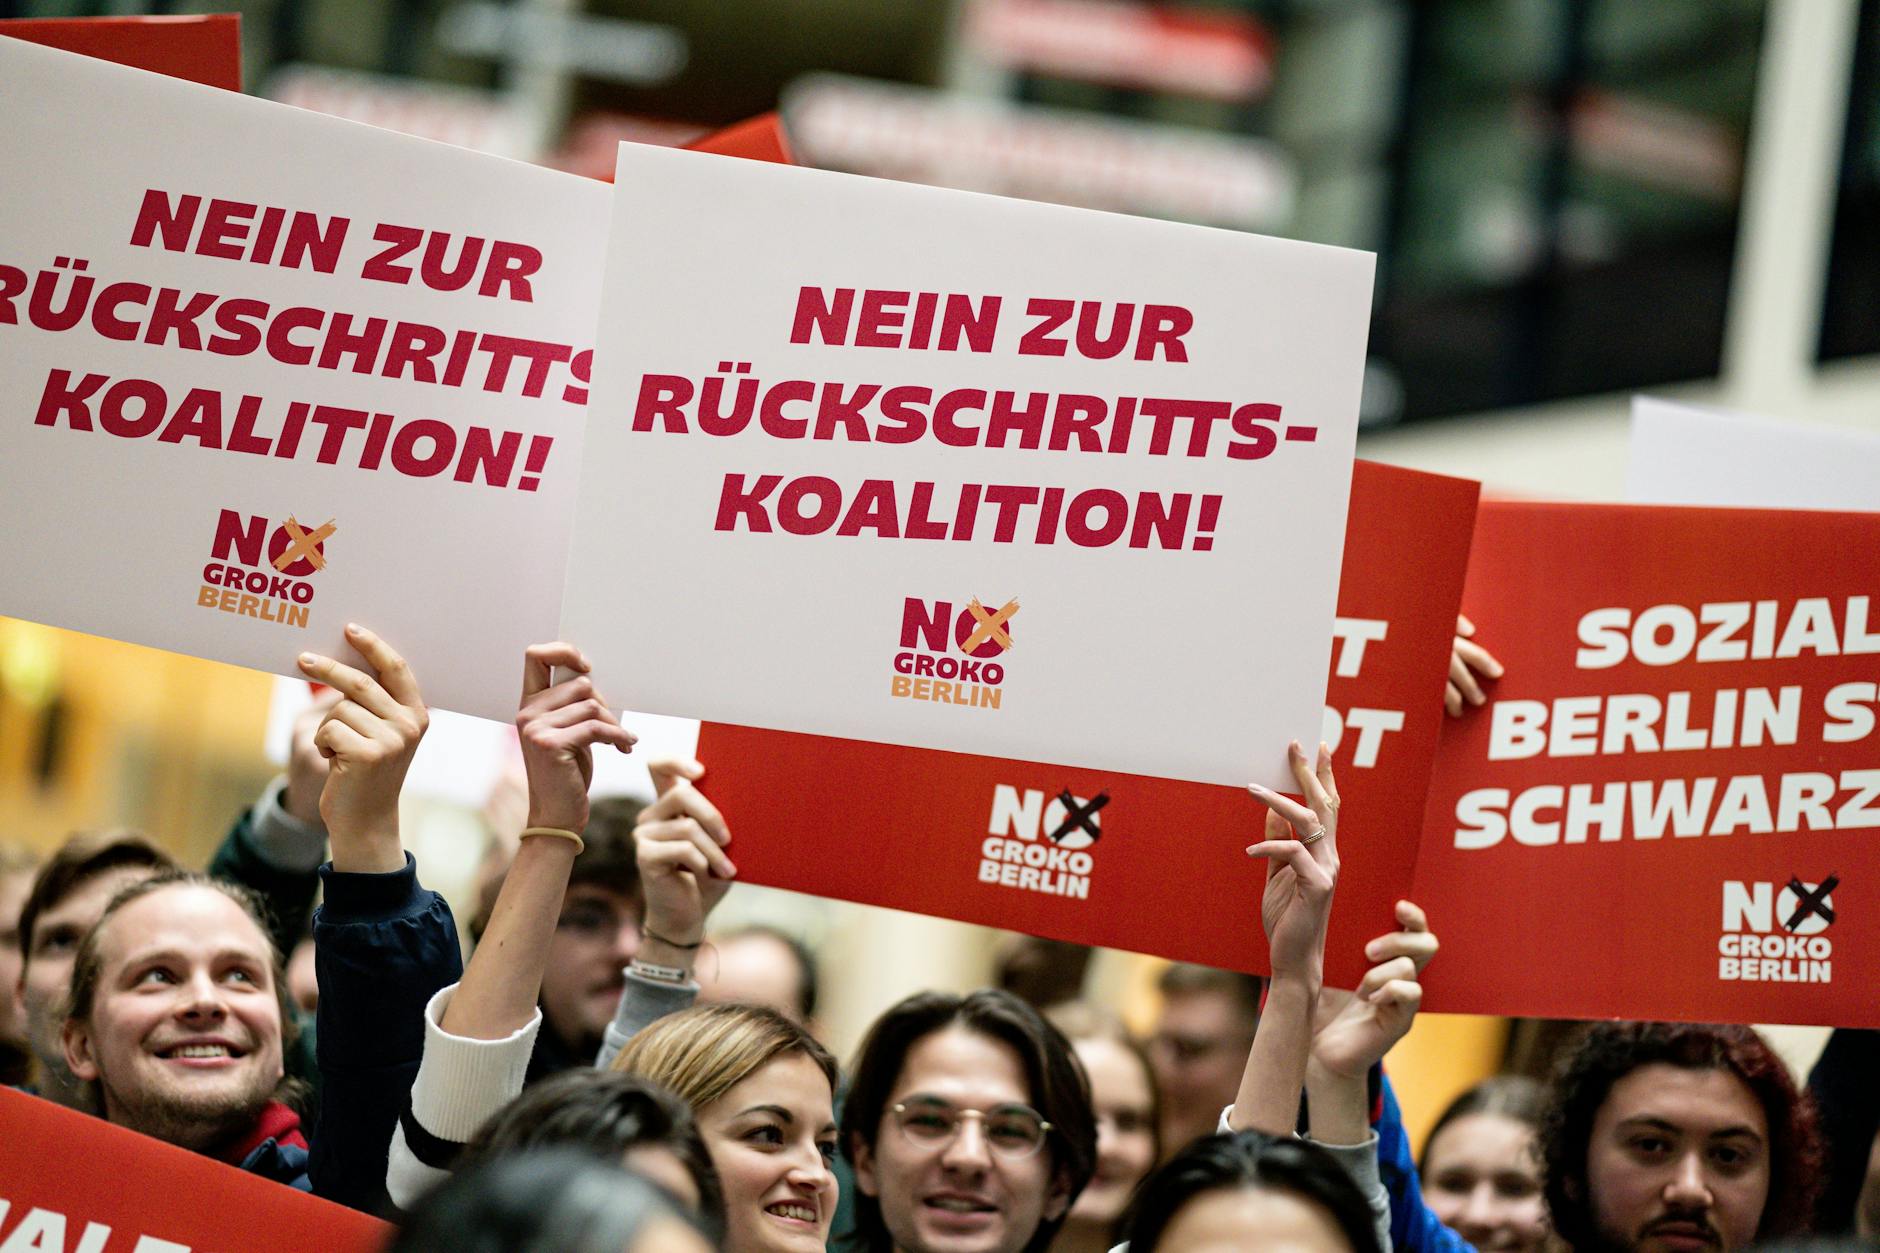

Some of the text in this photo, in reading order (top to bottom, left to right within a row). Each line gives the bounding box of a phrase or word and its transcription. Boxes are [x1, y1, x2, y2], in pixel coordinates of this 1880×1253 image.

[131, 189, 544, 303] NEIN ZUR
[790, 285, 1194, 364] NEIN ZUR
[35, 368, 555, 492] KOALITION!
[632, 360, 1318, 461] RÜCKSCHRITTS-
[714, 472, 1224, 552] KOALITION!
[197, 586, 310, 629] BERLIN
[202, 563, 314, 604] GROKO
[1575, 595, 1880, 670] SOZIAL
[890, 675, 1003, 710] BERLIN
[893, 651, 1005, 686] GROKO
[1487, 681, 1880, 762] BERLIN S
[1454, 769, 1880, 850] SCHWARZ
[978, 858, 1091, 900] BERLIN
[981, 836, 1093, 876] GROKO
[1718, 934, 1832, 960] GROKO
[1718, 956, 1832, 984] BERLIN
